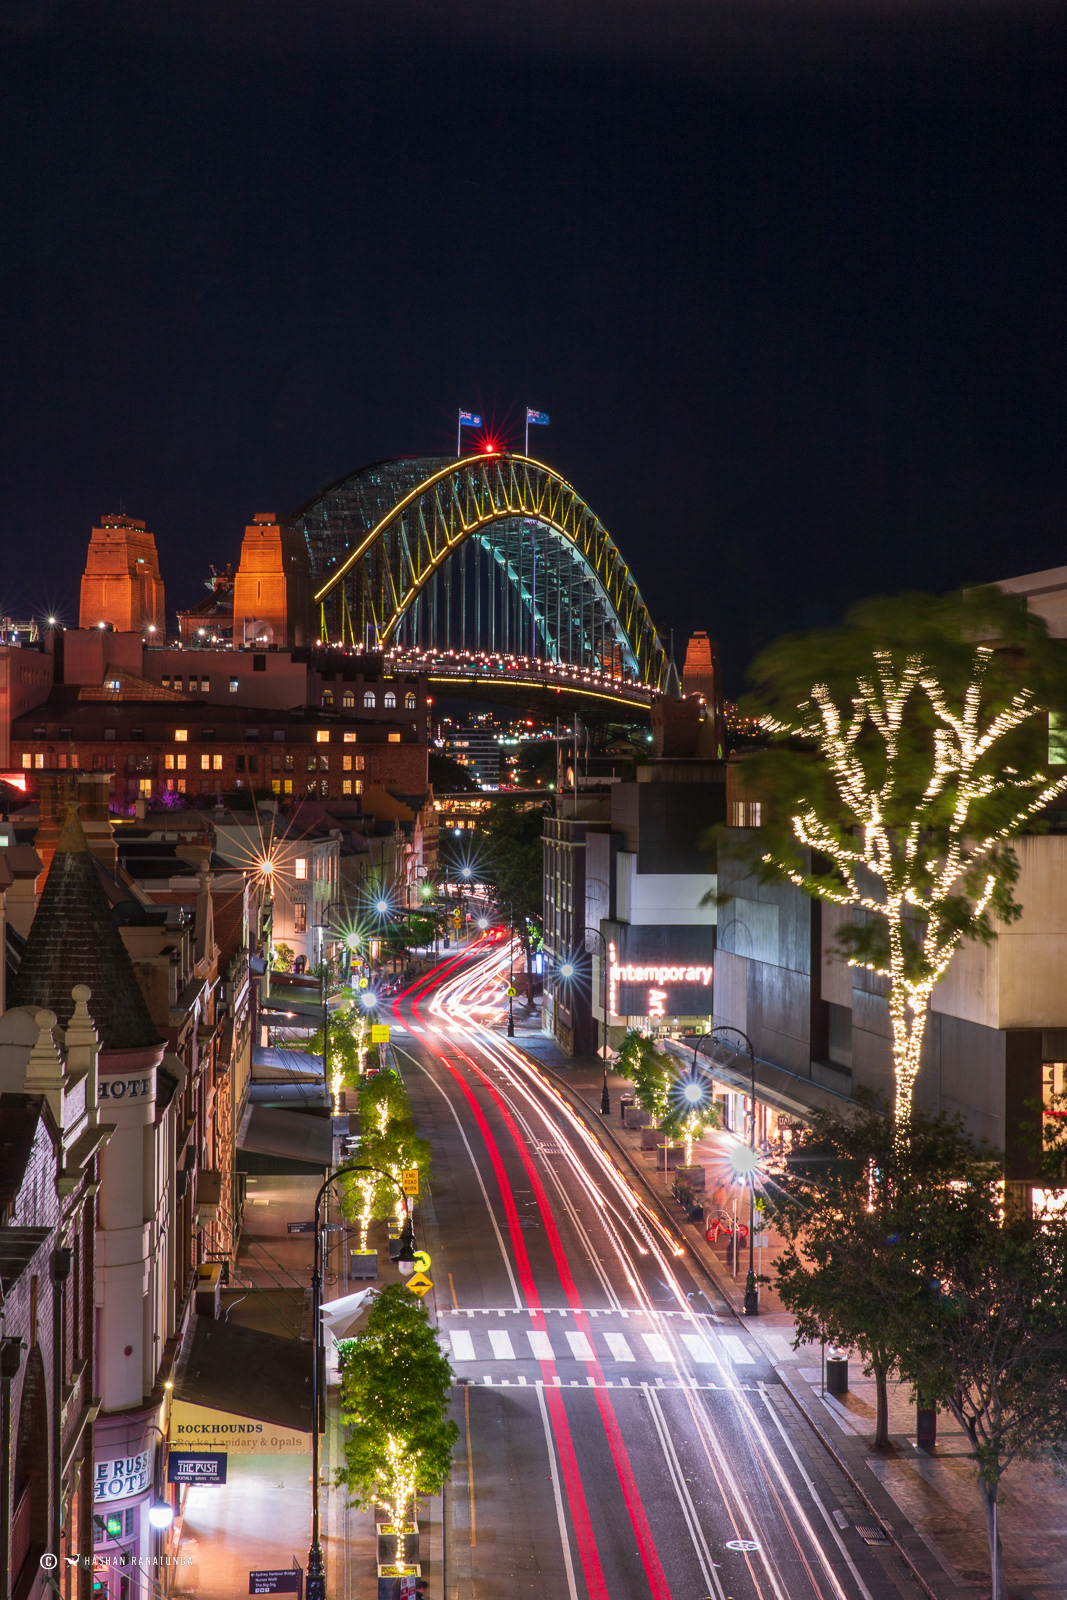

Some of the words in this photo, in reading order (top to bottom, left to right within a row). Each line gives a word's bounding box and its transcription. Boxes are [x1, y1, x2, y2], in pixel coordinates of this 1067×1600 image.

[648, 988, 667, 1017] Art
[177, 1424, 263, 1433] ROCKHOUNDS
[213, 1438, 258, 1449] Lapidary
[260, 1438, 268, 1446] &
[270, 1437, 302, 1446] Opals
[178, 1463, 194, 1473] THE
[195, 1463, 218, 1473] PUSH
